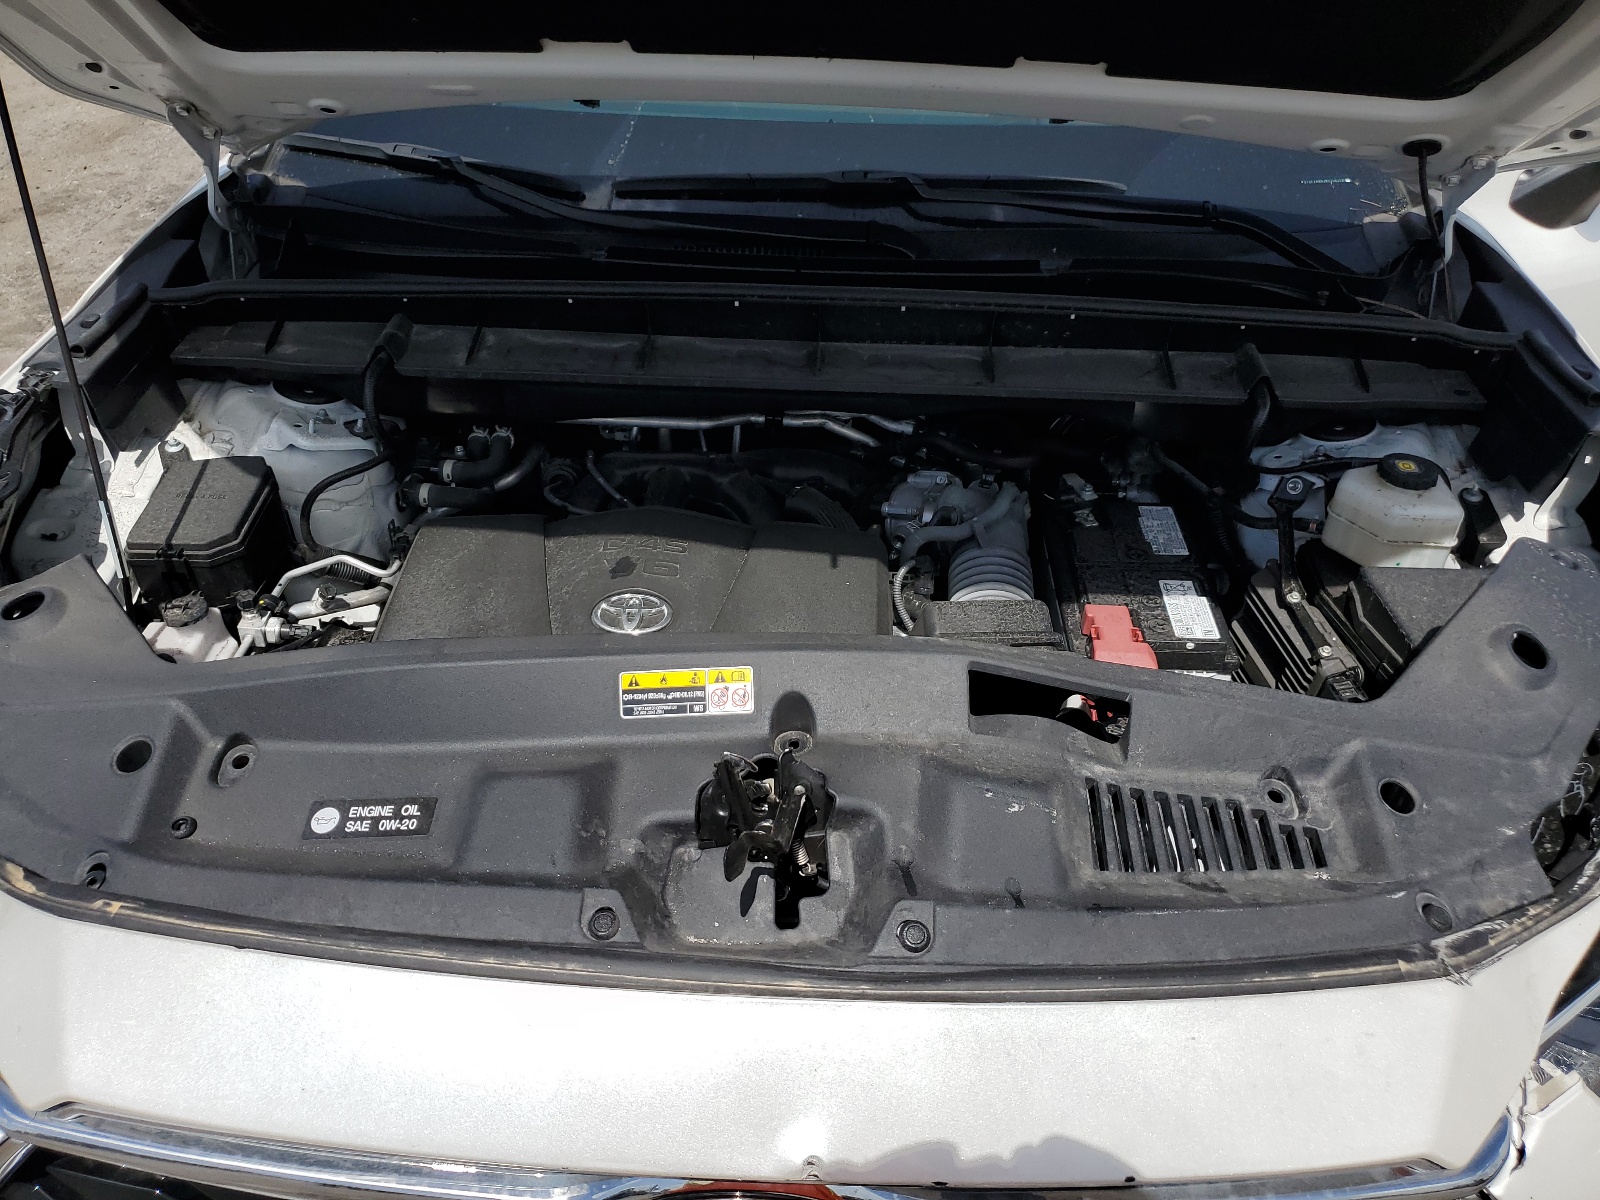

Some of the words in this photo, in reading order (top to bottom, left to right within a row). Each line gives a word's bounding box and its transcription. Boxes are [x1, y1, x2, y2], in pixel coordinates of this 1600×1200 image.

[348, 806, 394, 818] ENGINE
[401, 804, 420, 816] OIL
[345, 820, 371, 832] SAE
[378, 819, 417, 831] 0W-20
